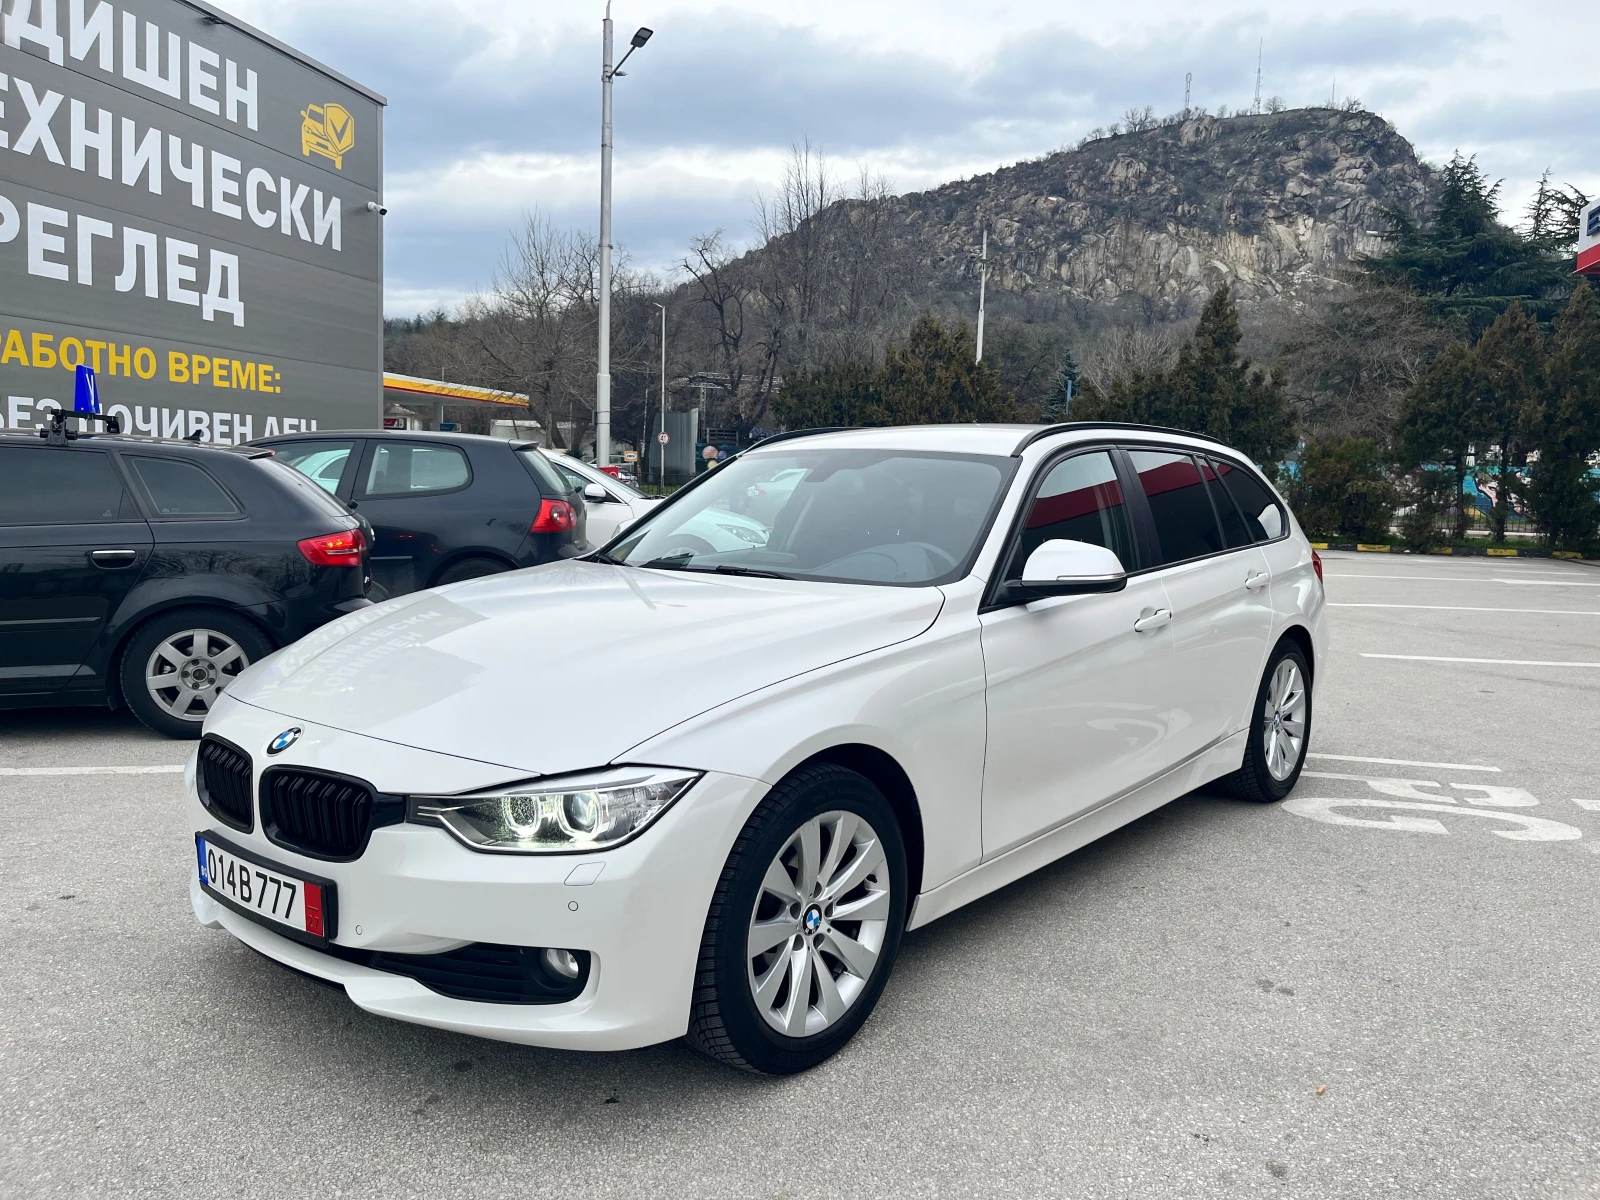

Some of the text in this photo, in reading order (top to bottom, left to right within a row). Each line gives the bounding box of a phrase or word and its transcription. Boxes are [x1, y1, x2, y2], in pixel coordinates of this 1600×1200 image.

[0, 0, 258, 131] ДИШЕН
[0, 72, 342, 251] ХНИЧЕСКИ
[0, 329, 281, 393] АБОТНО ВРЕМЕ:
[0, 395, 62, 436] ЕЗ
[208, 848, 297, 919] 014B777
